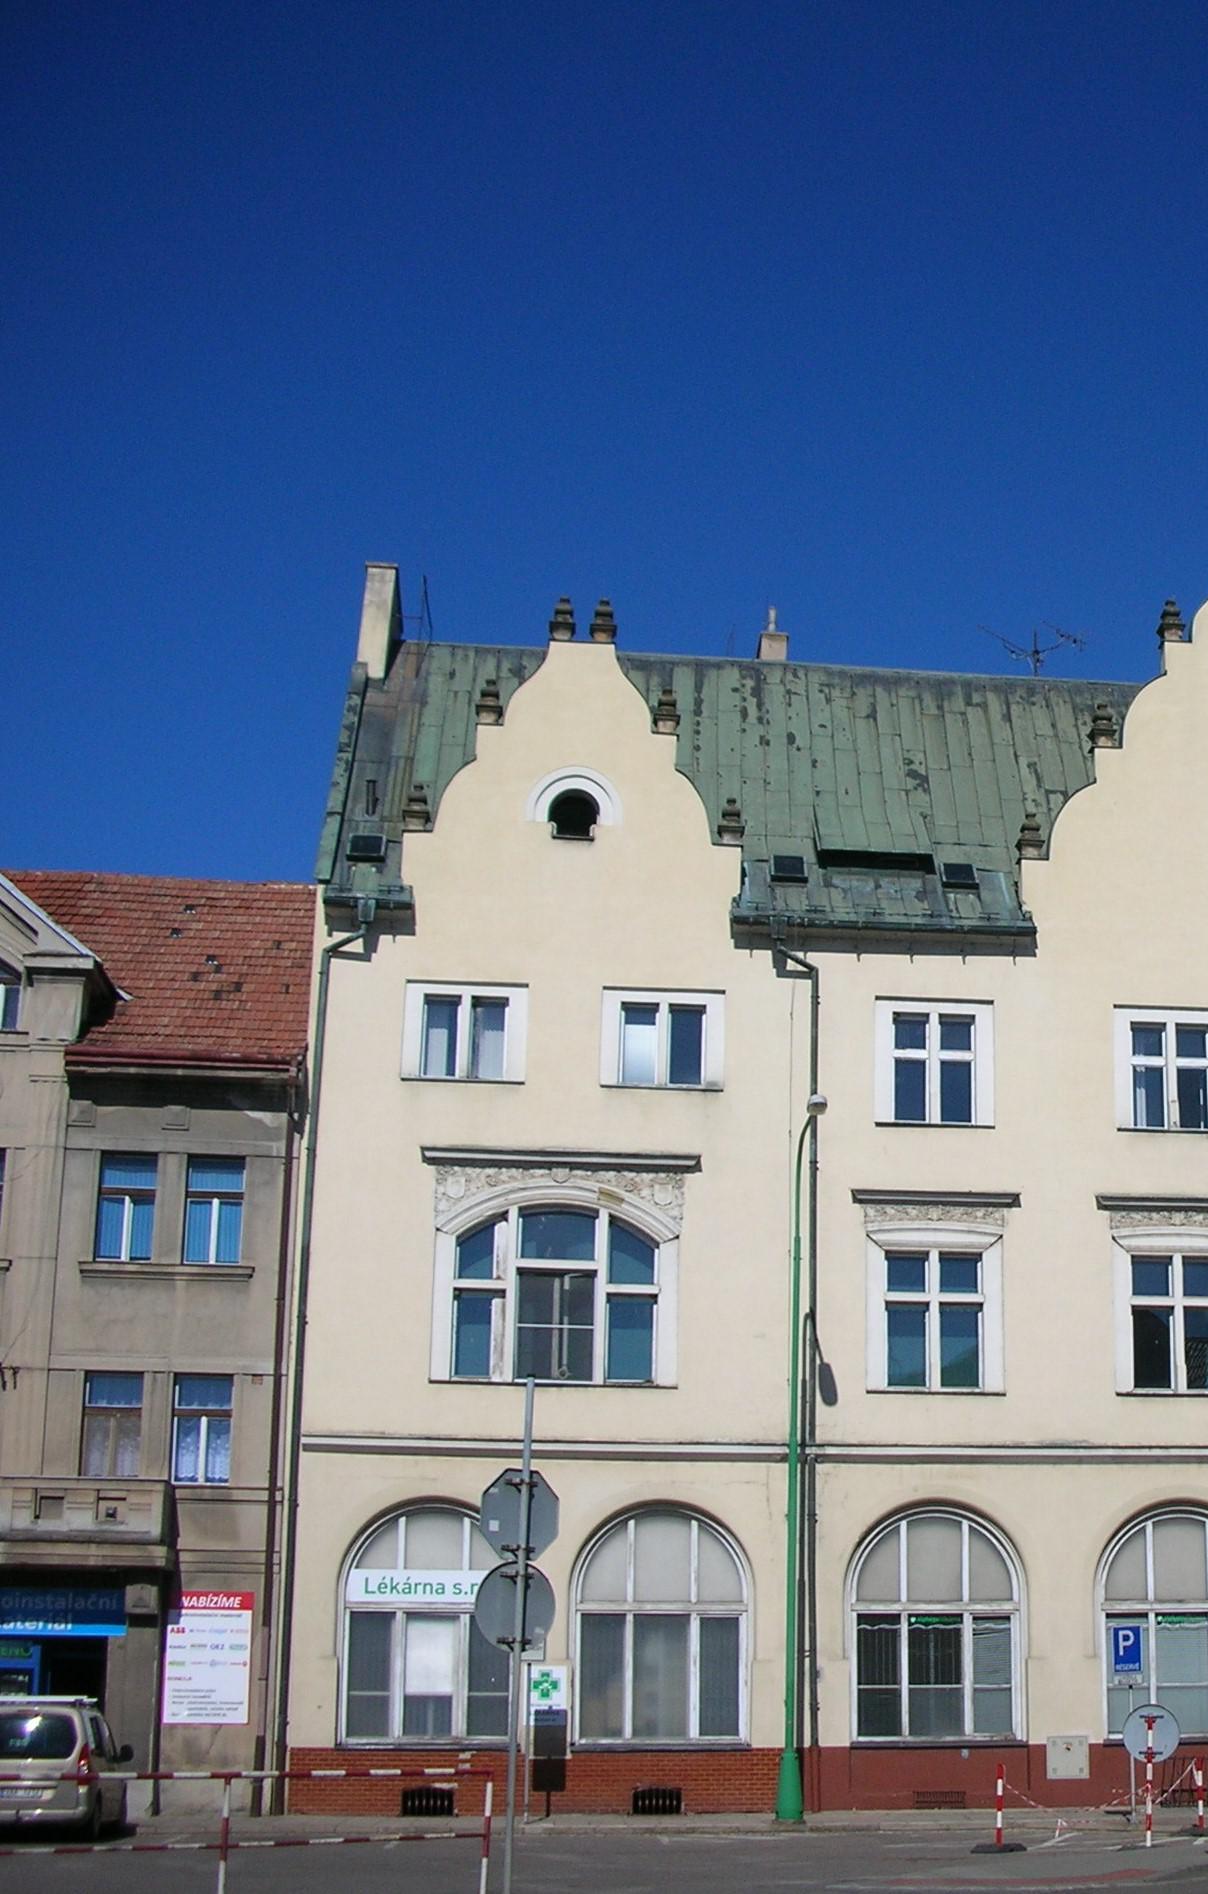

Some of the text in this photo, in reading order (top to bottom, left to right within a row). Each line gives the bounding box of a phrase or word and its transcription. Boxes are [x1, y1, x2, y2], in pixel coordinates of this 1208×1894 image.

[364, 1576, 446, 1596] Lékárna
[179, 1593, 243, 1608] NABÍZÍME
[1118, 1629, 1136, 1656] P
